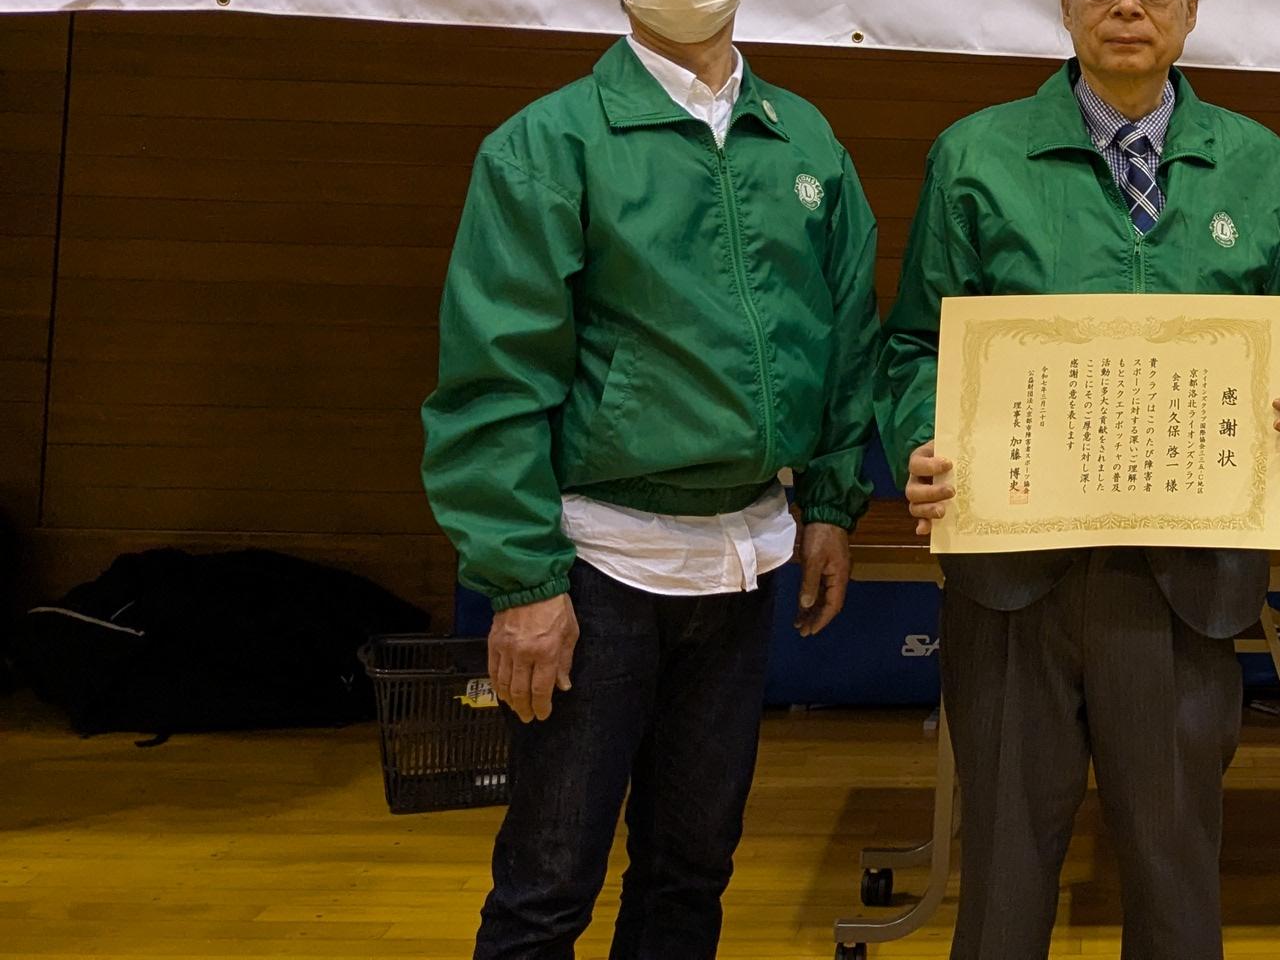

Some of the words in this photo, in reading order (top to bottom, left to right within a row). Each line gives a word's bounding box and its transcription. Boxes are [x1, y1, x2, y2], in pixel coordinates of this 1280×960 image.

[1067, 358, 1079, 451] 感謝の意を表します
[1080, 359, 1094, 494] ここにそのご厚意に対し深く
[1097, 358, 1111, 492] 活動に多大な貢献をされました
[1112, 358, 1125, 493] もとスクエアボッチャの普及
[1128, 359, 1142, 492] スポーツに対する深いご理解の
[1143, 357, 1158, 493] 貴クラブはこのたび障害者
[1185, 368, 1199, 490] 京都洛北ライオンズクラブ
[1217, 387, 1238, 468] 感謝状
